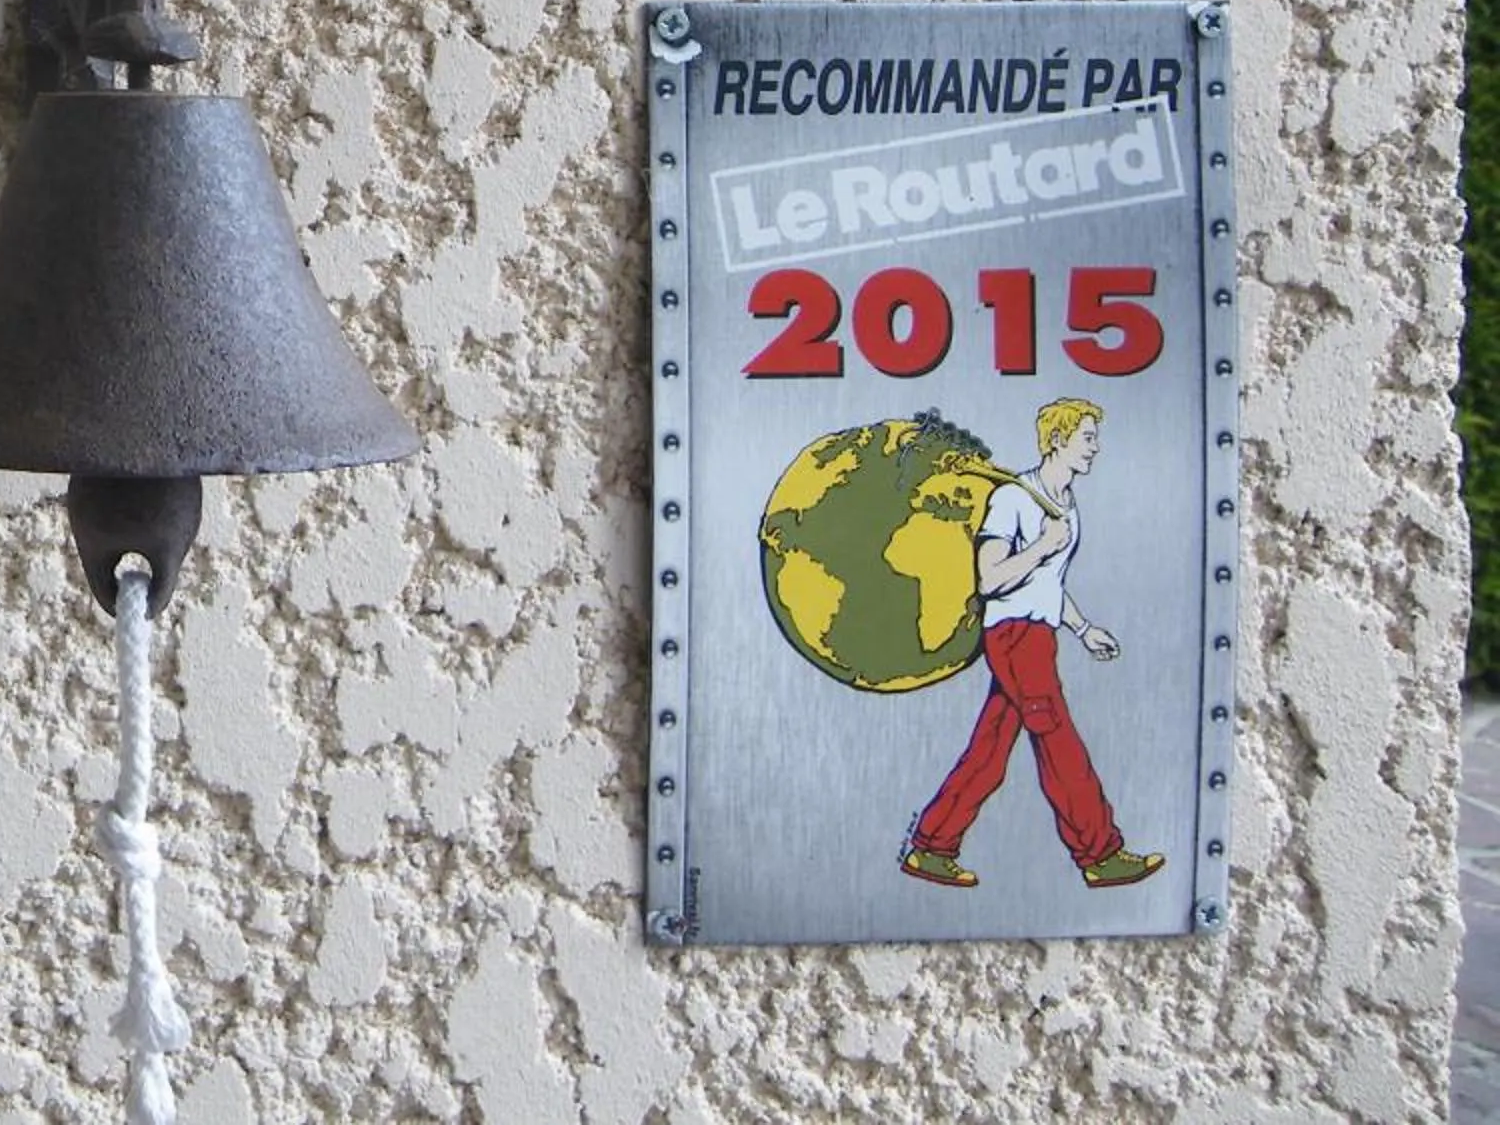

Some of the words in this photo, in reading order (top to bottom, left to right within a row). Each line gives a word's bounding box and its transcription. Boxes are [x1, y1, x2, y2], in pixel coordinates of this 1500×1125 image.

[712, 47, 1070, 116] RECOMMANDÉ
[1081, 57, 1183, 113] PAR
[740, 266, 1165, 379] 2015
